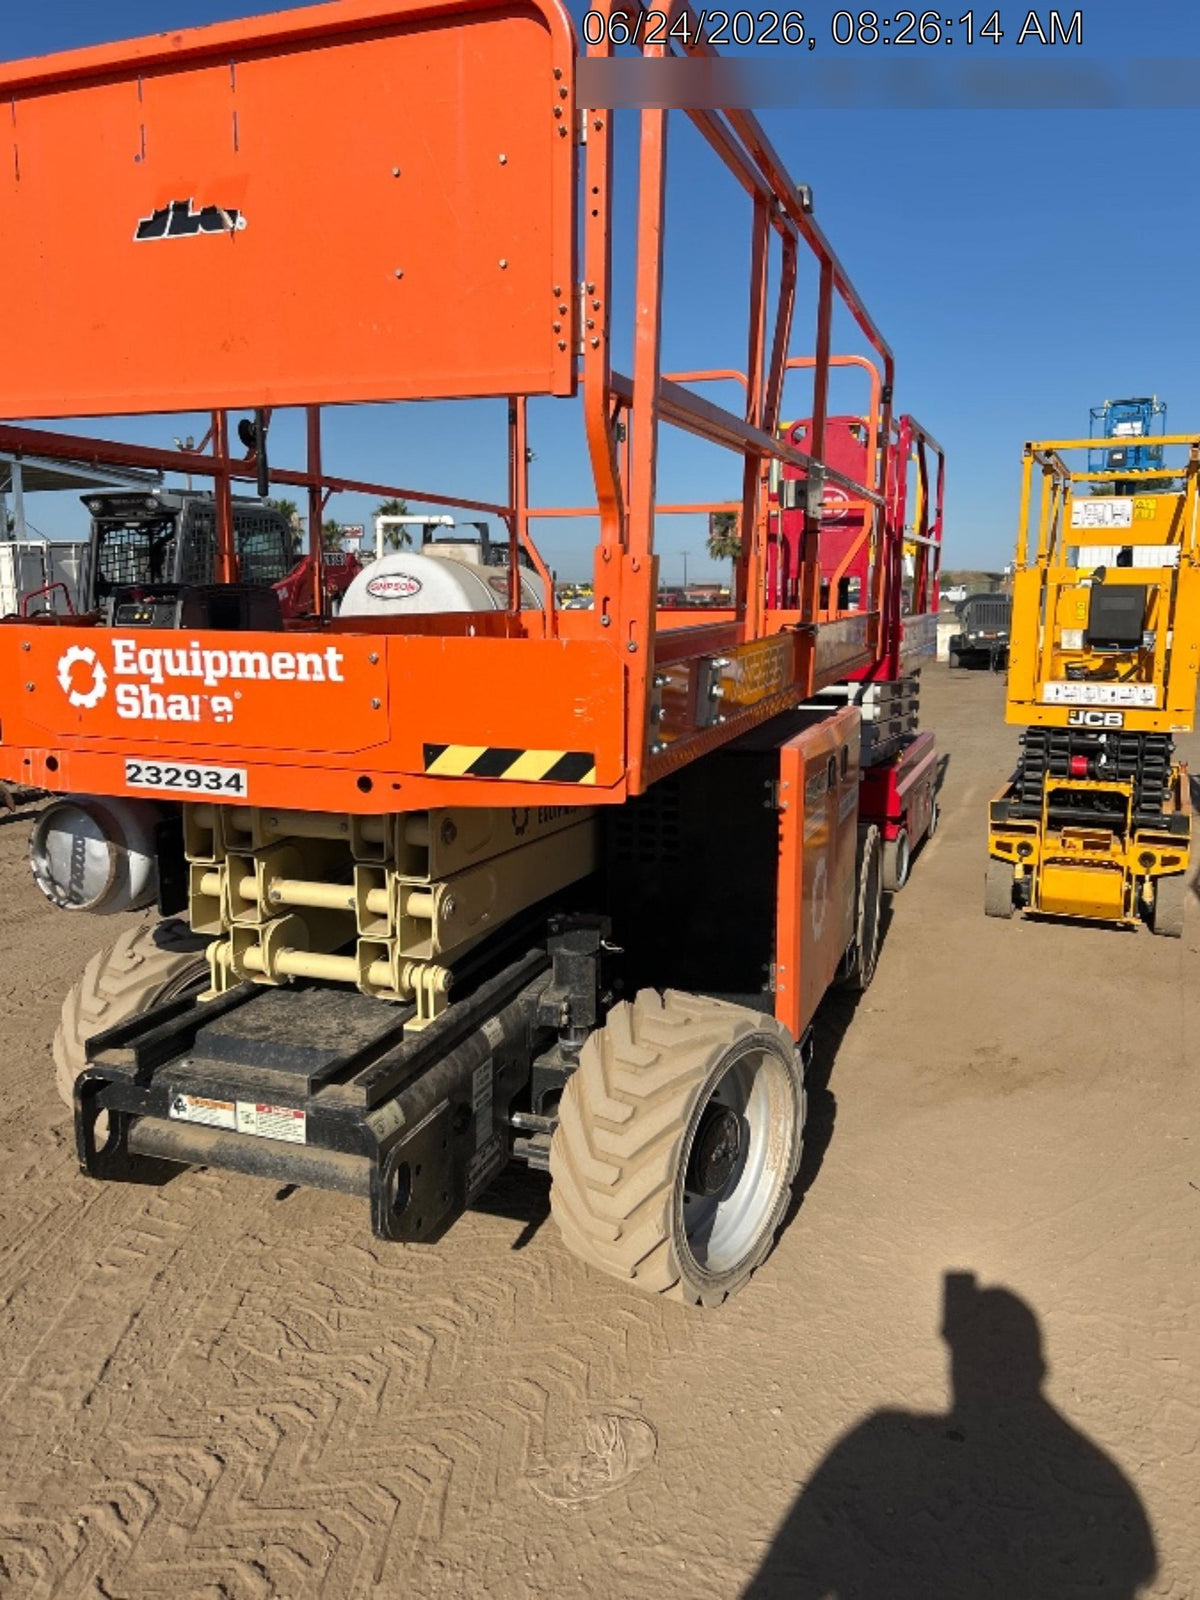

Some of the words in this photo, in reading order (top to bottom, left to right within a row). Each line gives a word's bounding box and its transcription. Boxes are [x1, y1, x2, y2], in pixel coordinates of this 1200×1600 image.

[370, 582, 416, 592] SIMPSON
[111, 639, 345, 686] Equipment
[1068, 711, 1123, 727] JCB
[125, 763, 244, 793] 232934
